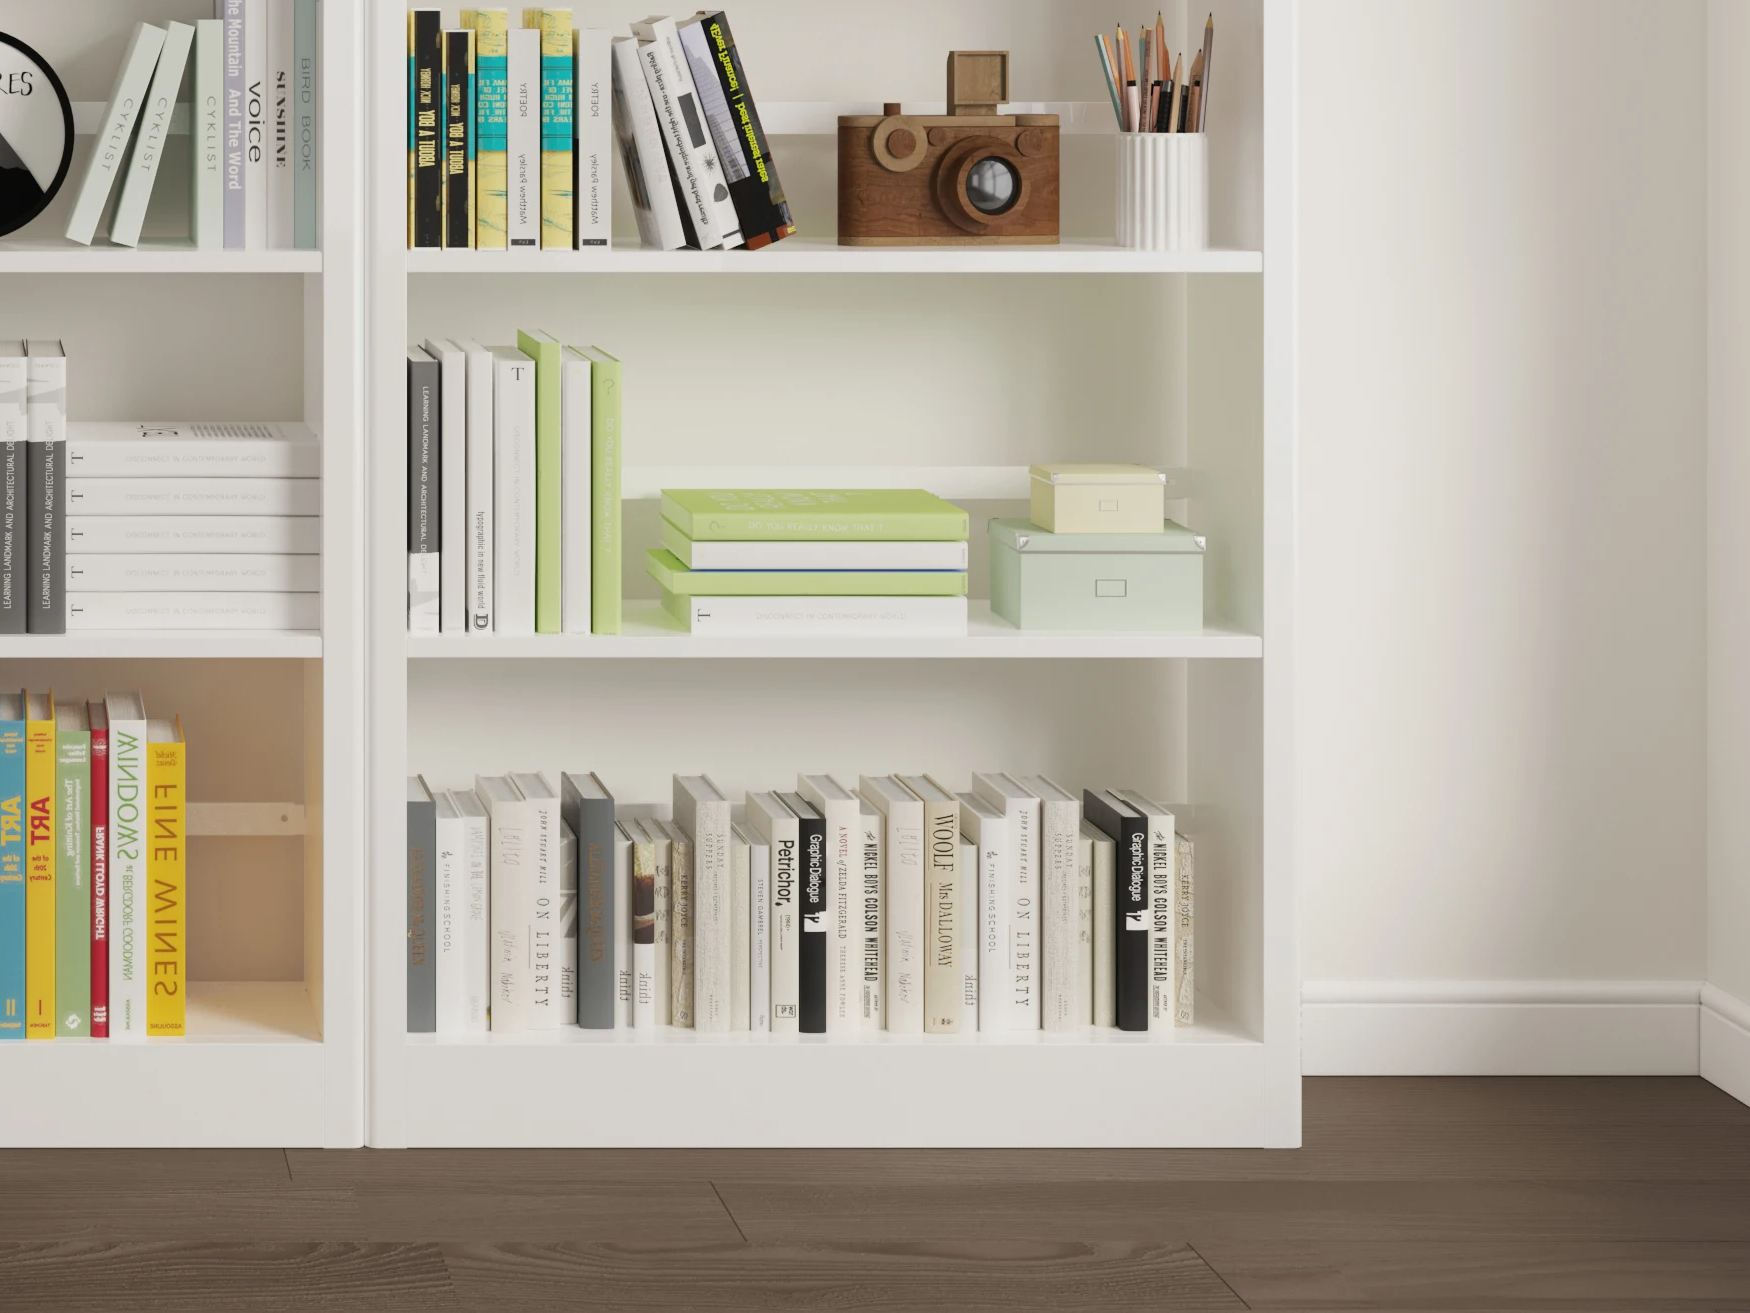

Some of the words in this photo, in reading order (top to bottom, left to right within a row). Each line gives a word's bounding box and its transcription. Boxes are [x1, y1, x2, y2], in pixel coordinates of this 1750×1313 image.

[228, 19, 241, 77] Mountain
[301, 58, 311, 103] BIRD
[228, 89, 241, 117] And
[248, 81, 265, 163] voice
[276, 71, 286, 167] SUNSHINE
[101, 98, 133, 171] CYKLIST
[140, 97, 168, 172] CYKLIST
[207, 96, 216, 172] CYKLIST
[228, 121, 241, 147] The
[301, 116, 311, 171] BOOK
[228, 152, 241, 190] Word
[476, 511, 486, 549] typographic
[477, 575, 485, 589] fluid
[477, 590, 485, 609] world
[933, 813, 953, 872] WOOLF
[1130, 832, 1143, 865] Graphic
[1153, 843, 1167, 870] NICKEL
[938, 882, 952, 900] Mrs
[1130, 866, 1143, 901] Dialogue
[1153, 874, 1167, 894] BOYS
[1016, 898, 1029, 919] ON
[1153, 898, 1167, 932] COLSON
[938, 902, 952, 967] DALLOWAY
[1016, 932, 1029, 1007] LIBERTY
[1153, 937, 1167, 981] WHITEHEAD
